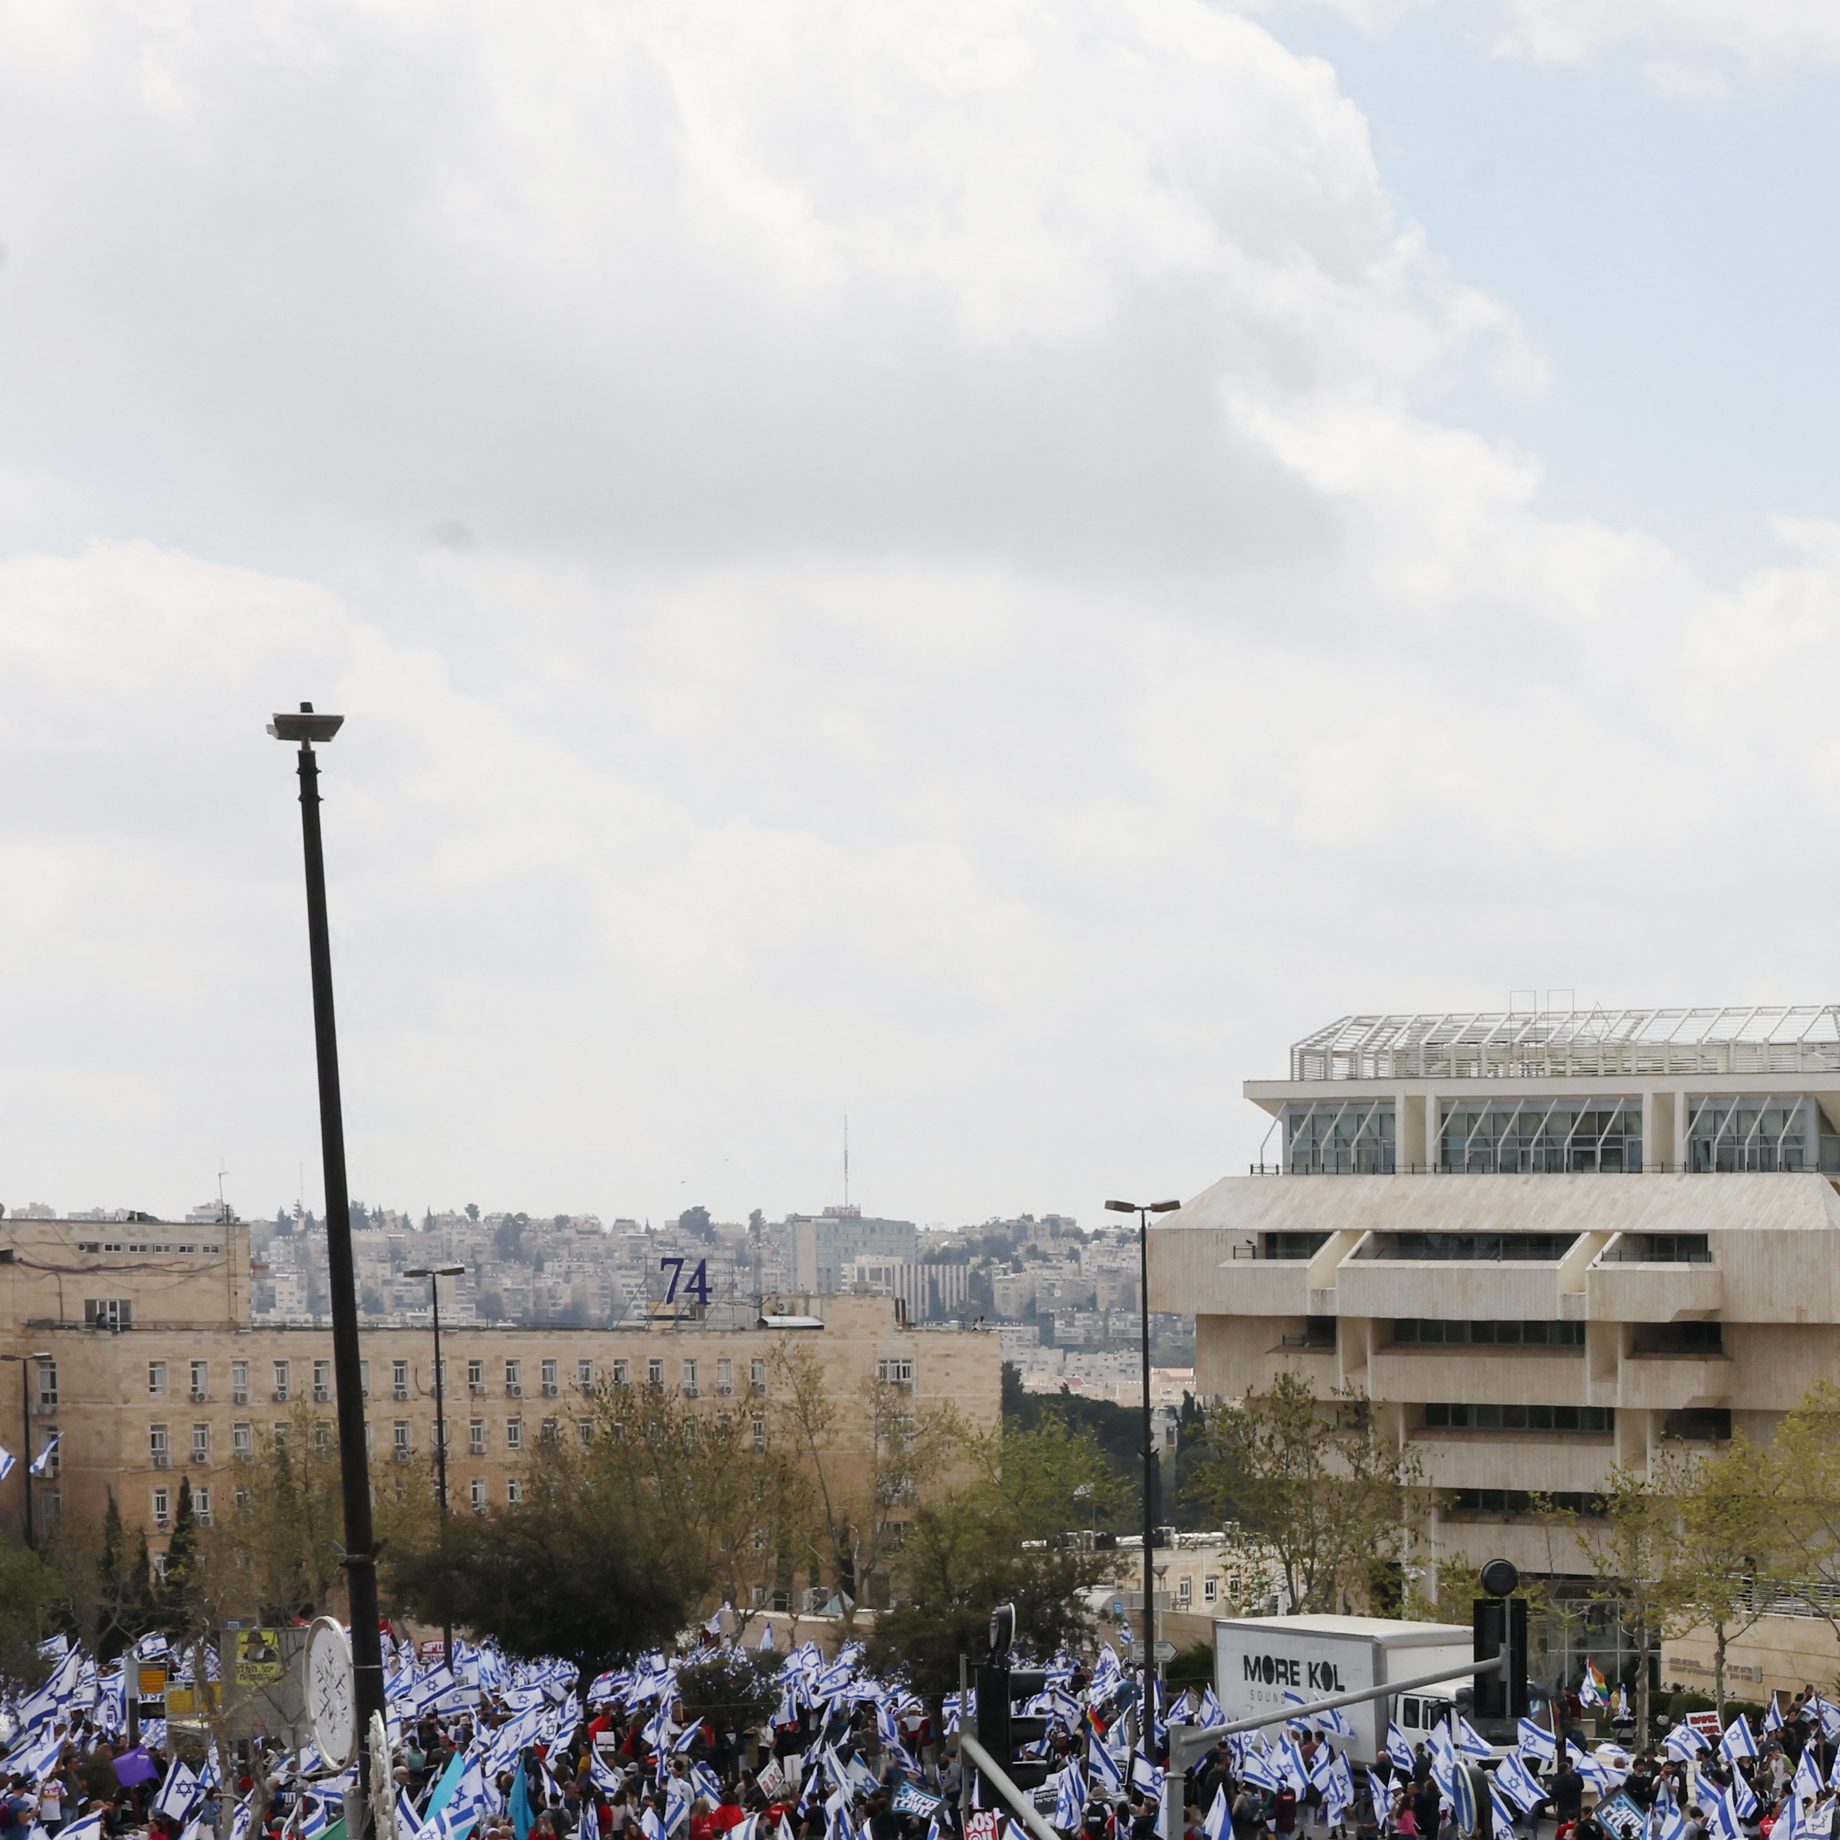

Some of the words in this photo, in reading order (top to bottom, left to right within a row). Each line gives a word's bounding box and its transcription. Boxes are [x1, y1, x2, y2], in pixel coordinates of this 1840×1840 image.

[660, 1258, 714, 1305] 74
[1243, 1655, 1301, 1687] MORE
[1308, 1661, 1346, 1692] KOL
[966, 1812, 994, 1834] SOS
